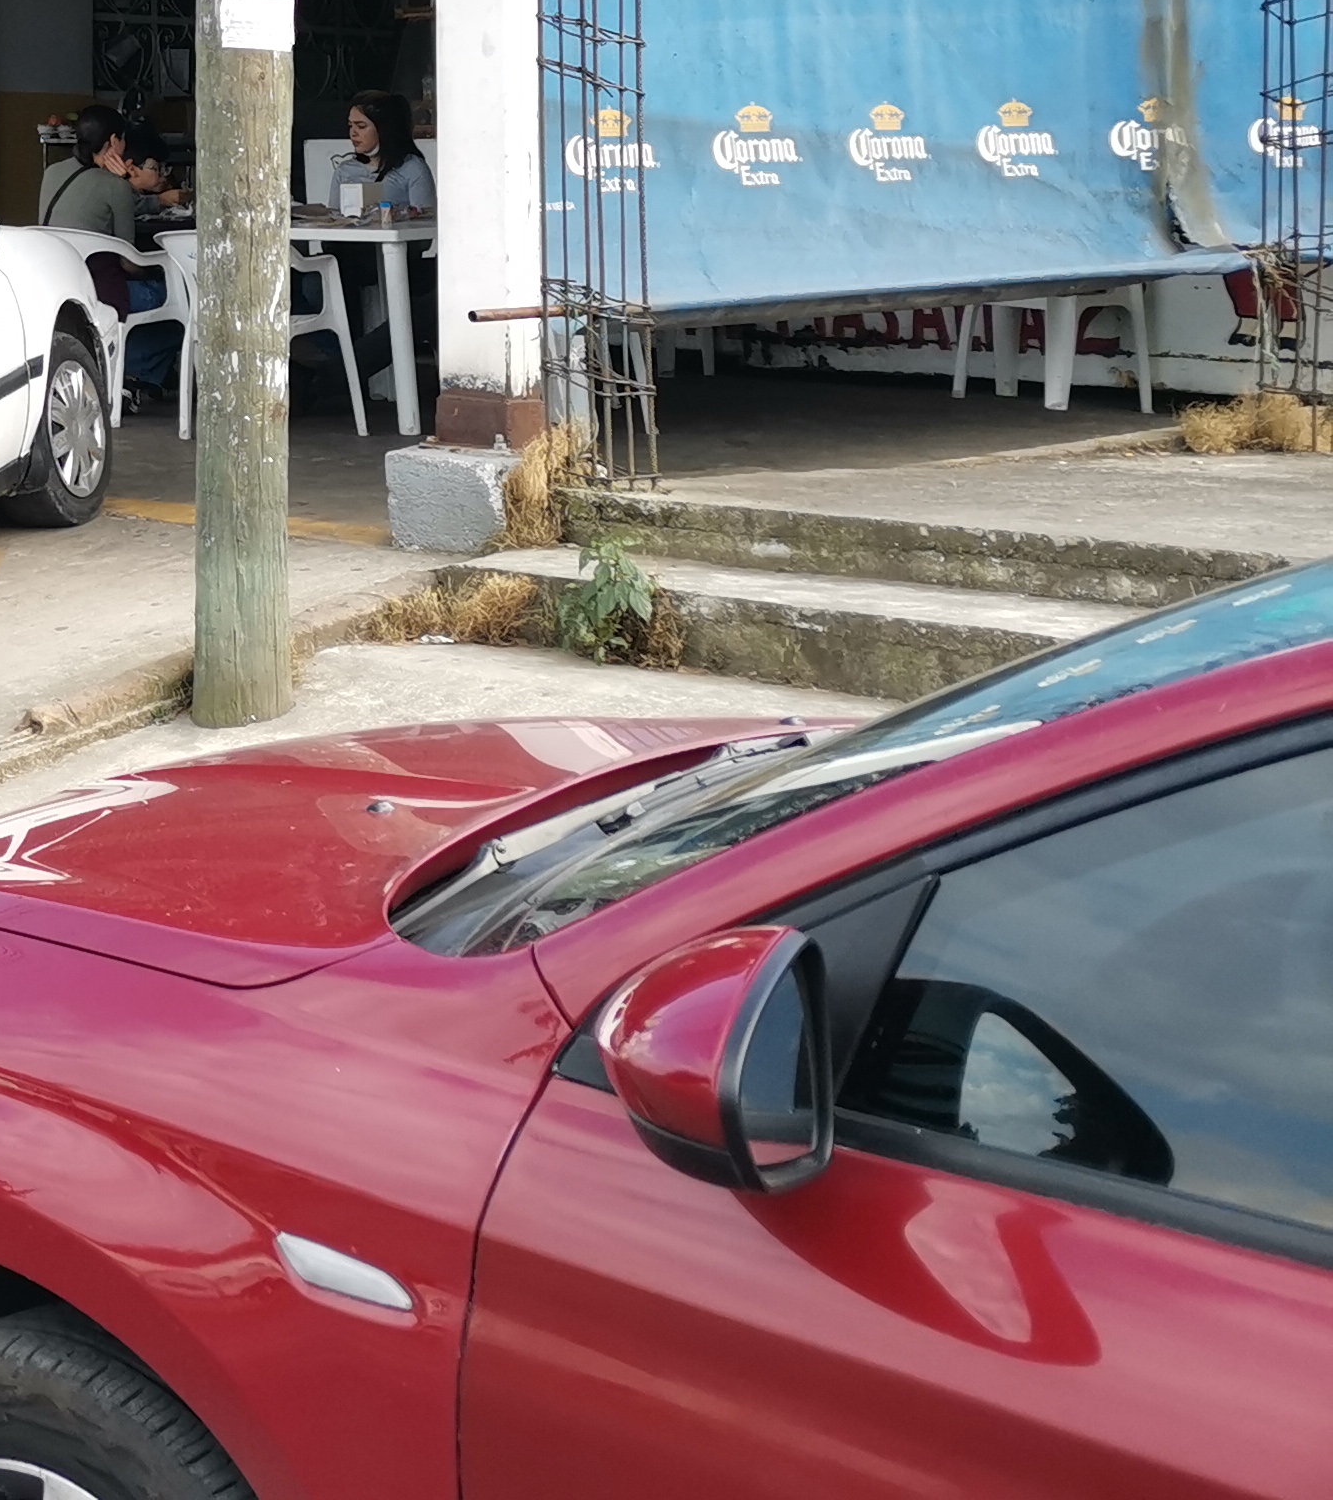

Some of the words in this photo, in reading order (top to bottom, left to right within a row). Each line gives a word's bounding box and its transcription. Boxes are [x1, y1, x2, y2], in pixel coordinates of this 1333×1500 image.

[712, 129, 799, 174] Corona
[848, 127, 929, 170] Corona
[976, 124, 1056, 166] Corona
[740, 165, 781, 186] Extra
[874, 162, 912, 182] Extra
[1002, 157, 1039, 177] Extra
